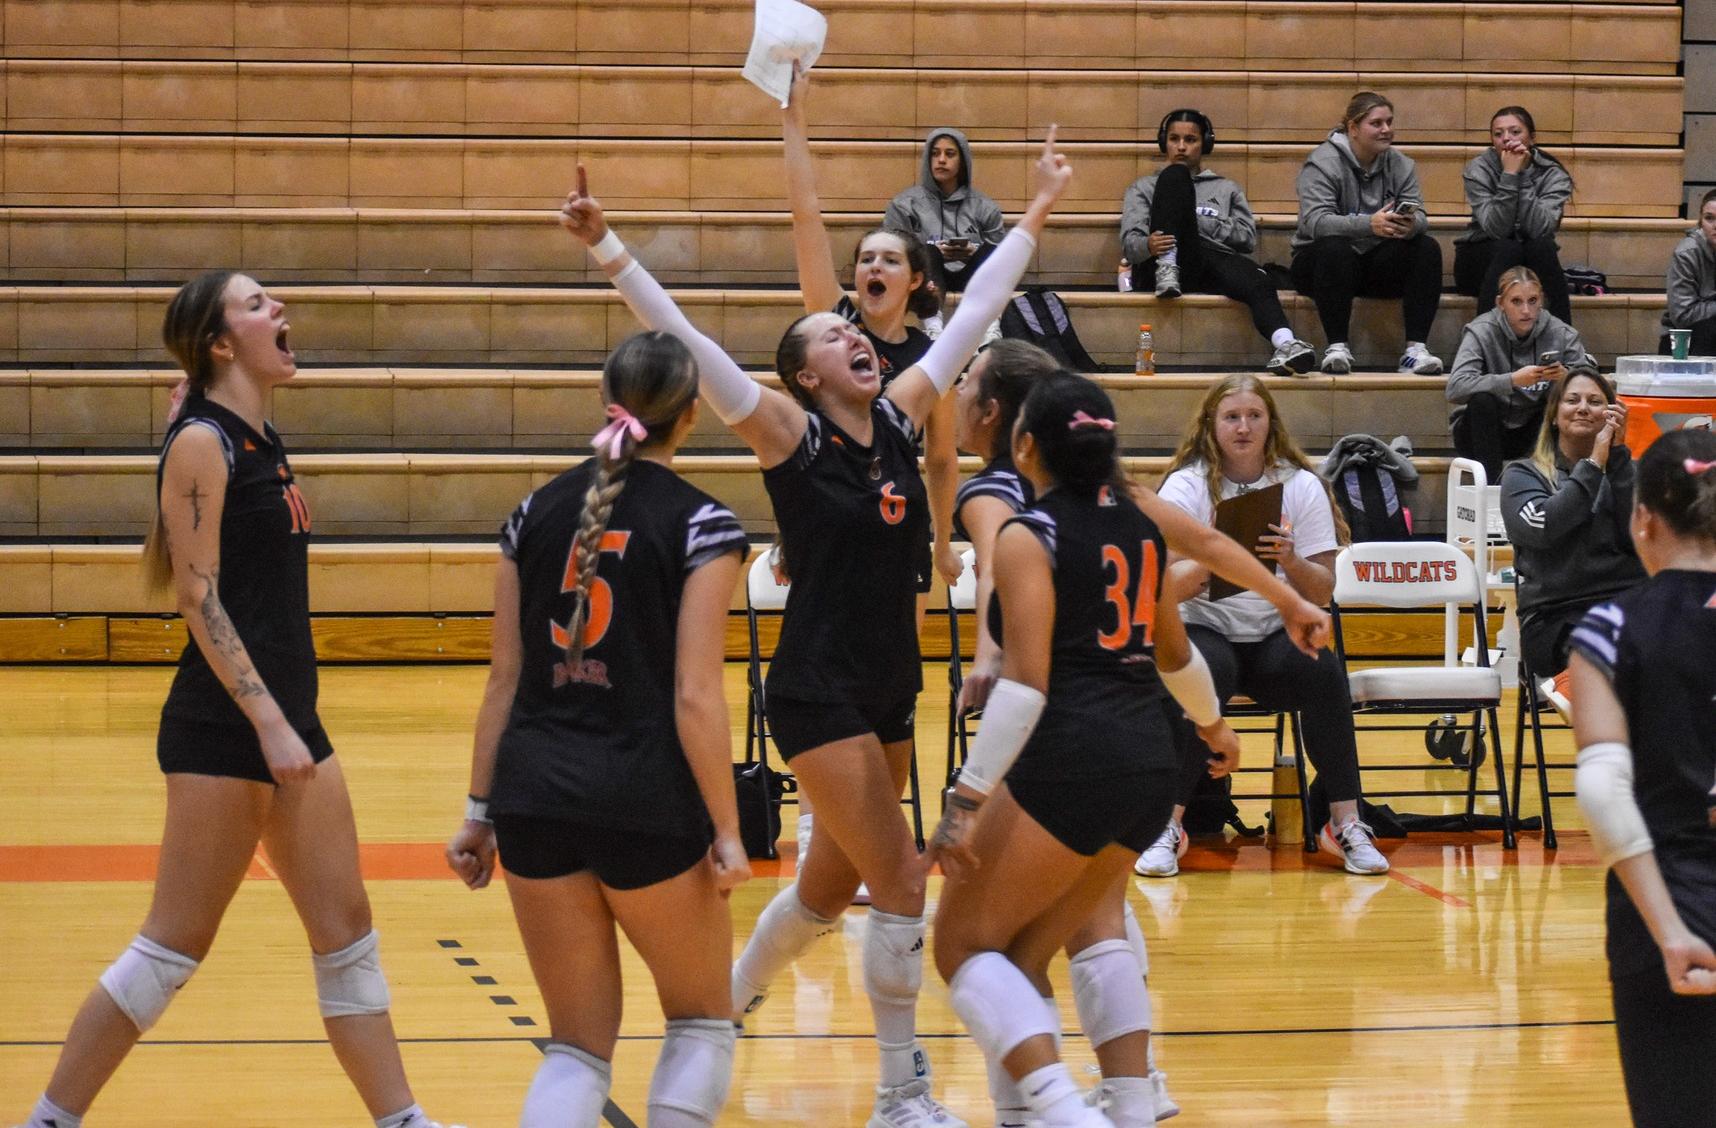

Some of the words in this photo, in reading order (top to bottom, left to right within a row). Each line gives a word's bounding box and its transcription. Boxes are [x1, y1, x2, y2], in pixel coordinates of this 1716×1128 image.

[282, 484, 312, 534] 10
[879, 481, 907, 525] 6
[549, 529, 632, 650] 5
[1097, 539, 1159, 651] 34
[1353, 560, 1458, 583] WILDCATS
